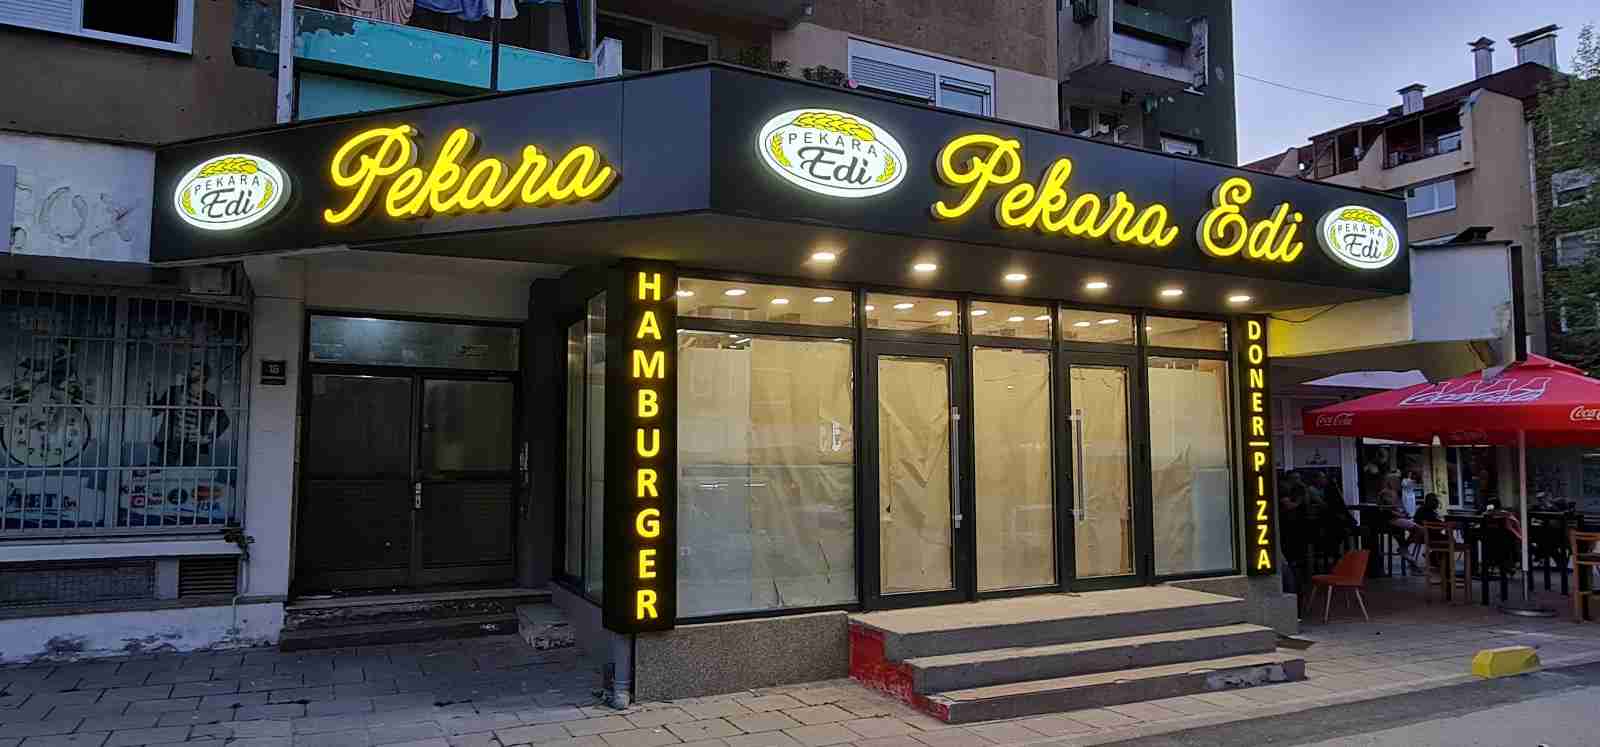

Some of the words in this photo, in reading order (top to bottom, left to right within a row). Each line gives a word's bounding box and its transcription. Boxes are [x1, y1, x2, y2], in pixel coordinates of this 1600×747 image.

[788, 131, 878, 158] PEKARA
[194, 175, 260, 195] PEKARA
[323, 124, 613, 224] Pekara
[797, 146, 872, 185] Edi
[200, 187, 254, 218] Edi
[934, 133, 1180, 248] Pekara
[1202, 176, 1304, 263] Edi
[1337, 223, 1384, 238] PEKARA
[1343, 233, 1382, 259] Edi
[1247, 320, 1265, 437] DONER
[632, 271, 665, 621] HAMBURGER
[1253, 451, 1272, 570] PIZZA
